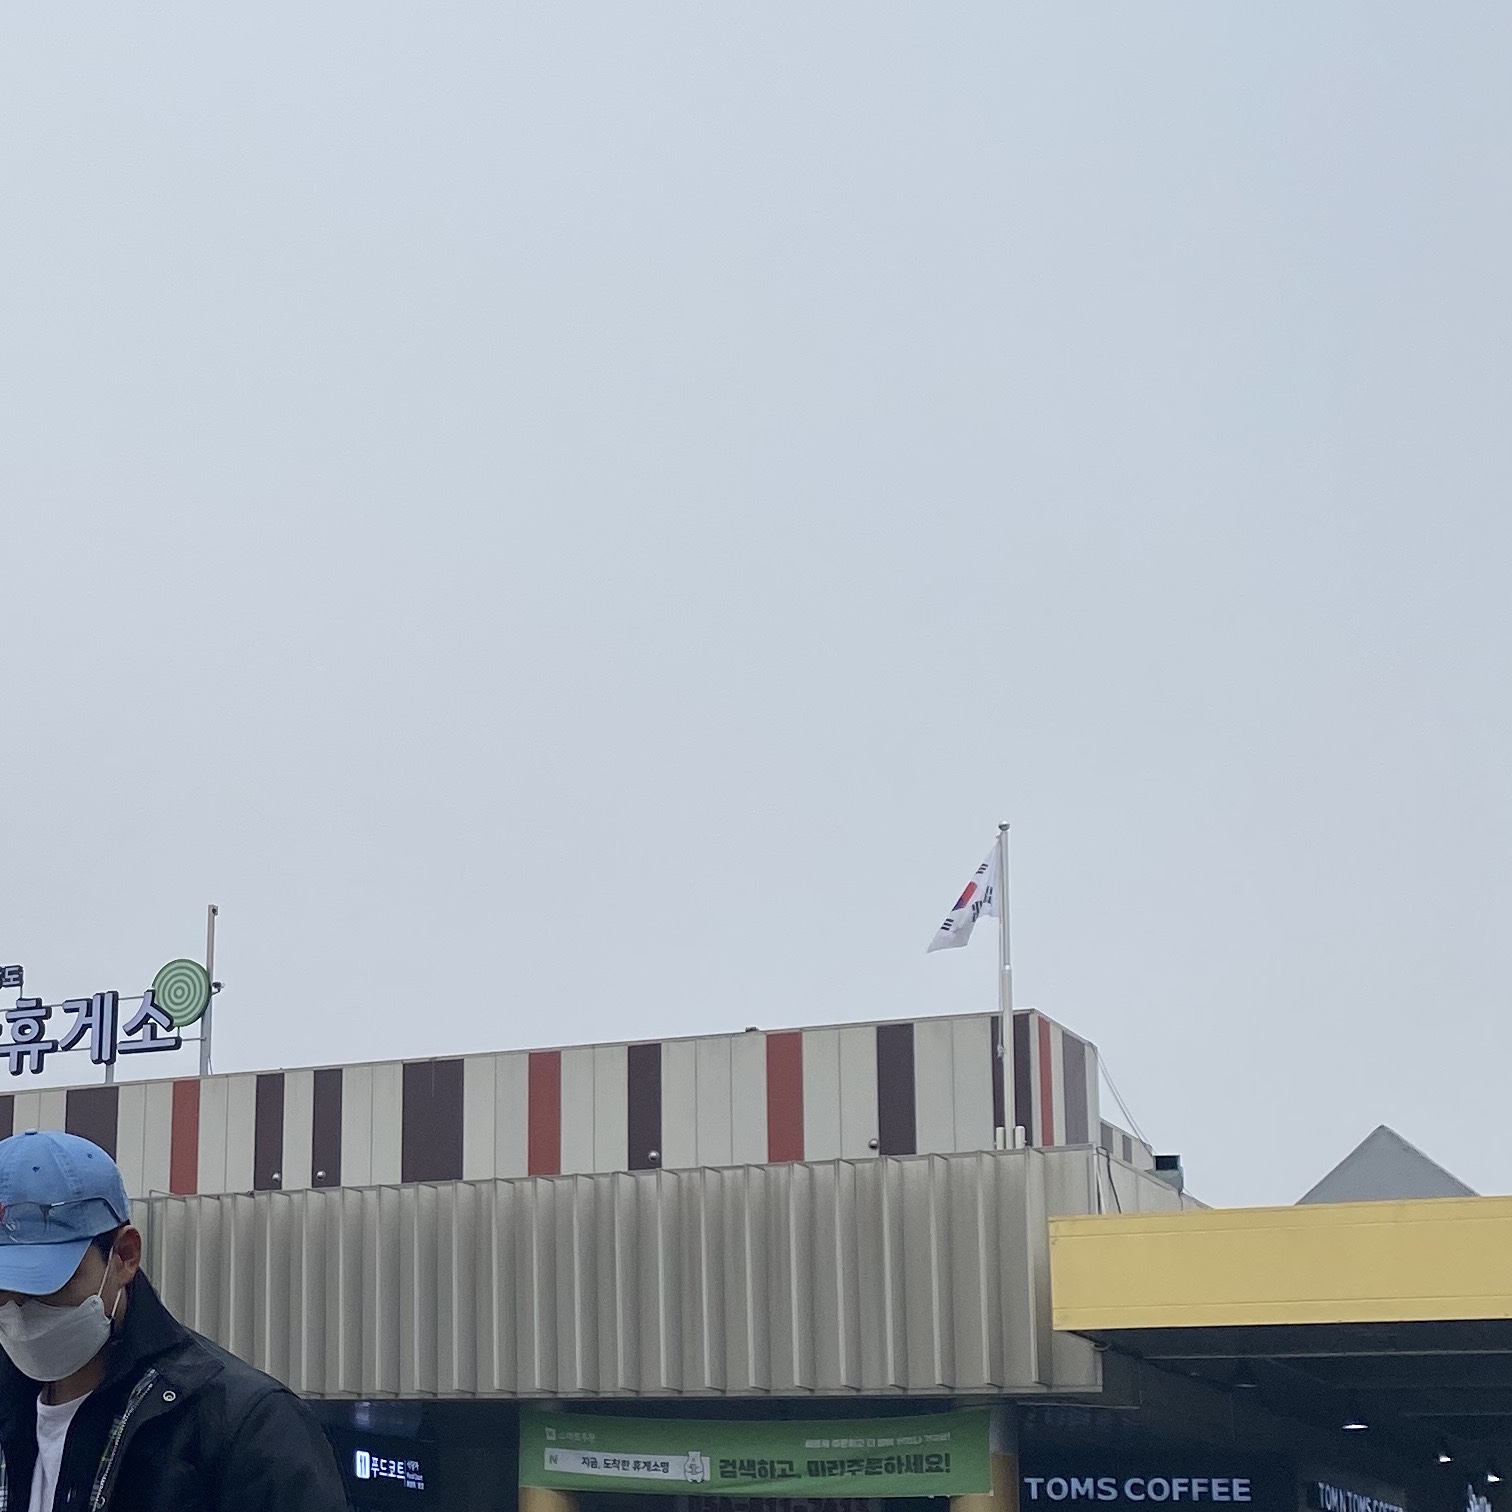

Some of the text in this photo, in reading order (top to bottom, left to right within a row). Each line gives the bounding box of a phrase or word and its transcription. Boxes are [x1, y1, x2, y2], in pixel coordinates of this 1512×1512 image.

[371, 1456, 406, 1480] 푸드코트
[581, 1456, 670, 1474] 지금, 도착한 휴게소명
[806, 1452, 951, 1478] 미리주문하세요!
[1024, 1477, 1252, 1501] TOMS COFFEE
